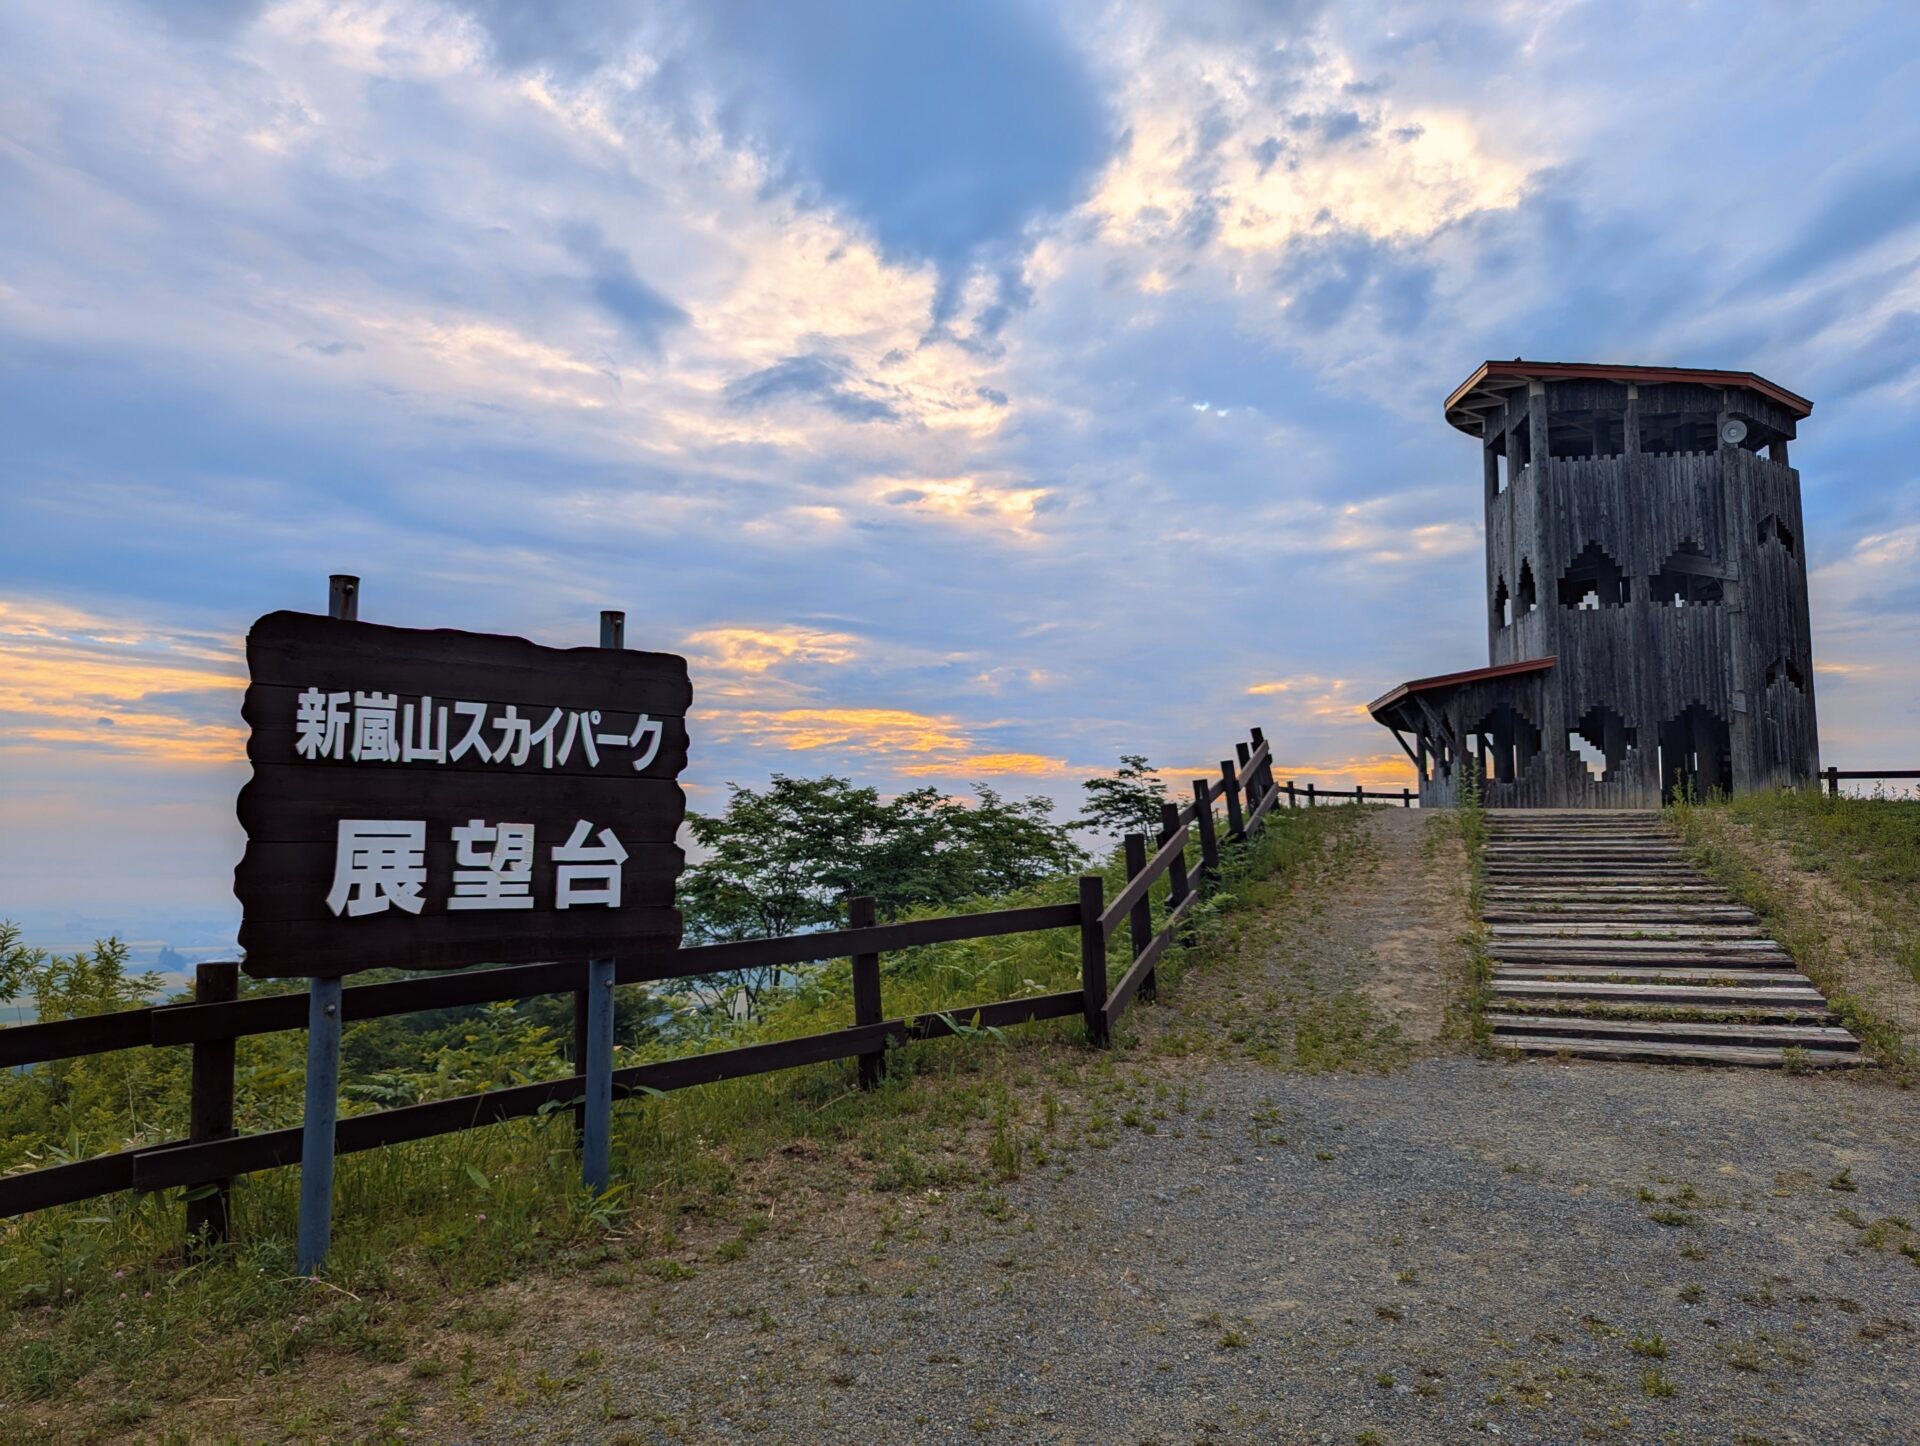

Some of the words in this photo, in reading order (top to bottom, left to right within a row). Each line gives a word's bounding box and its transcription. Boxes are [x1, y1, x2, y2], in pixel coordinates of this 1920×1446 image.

[297, 687, 663, 771] 新嵐山スカイパーク
[326, 819, 629, 917] 展望台
